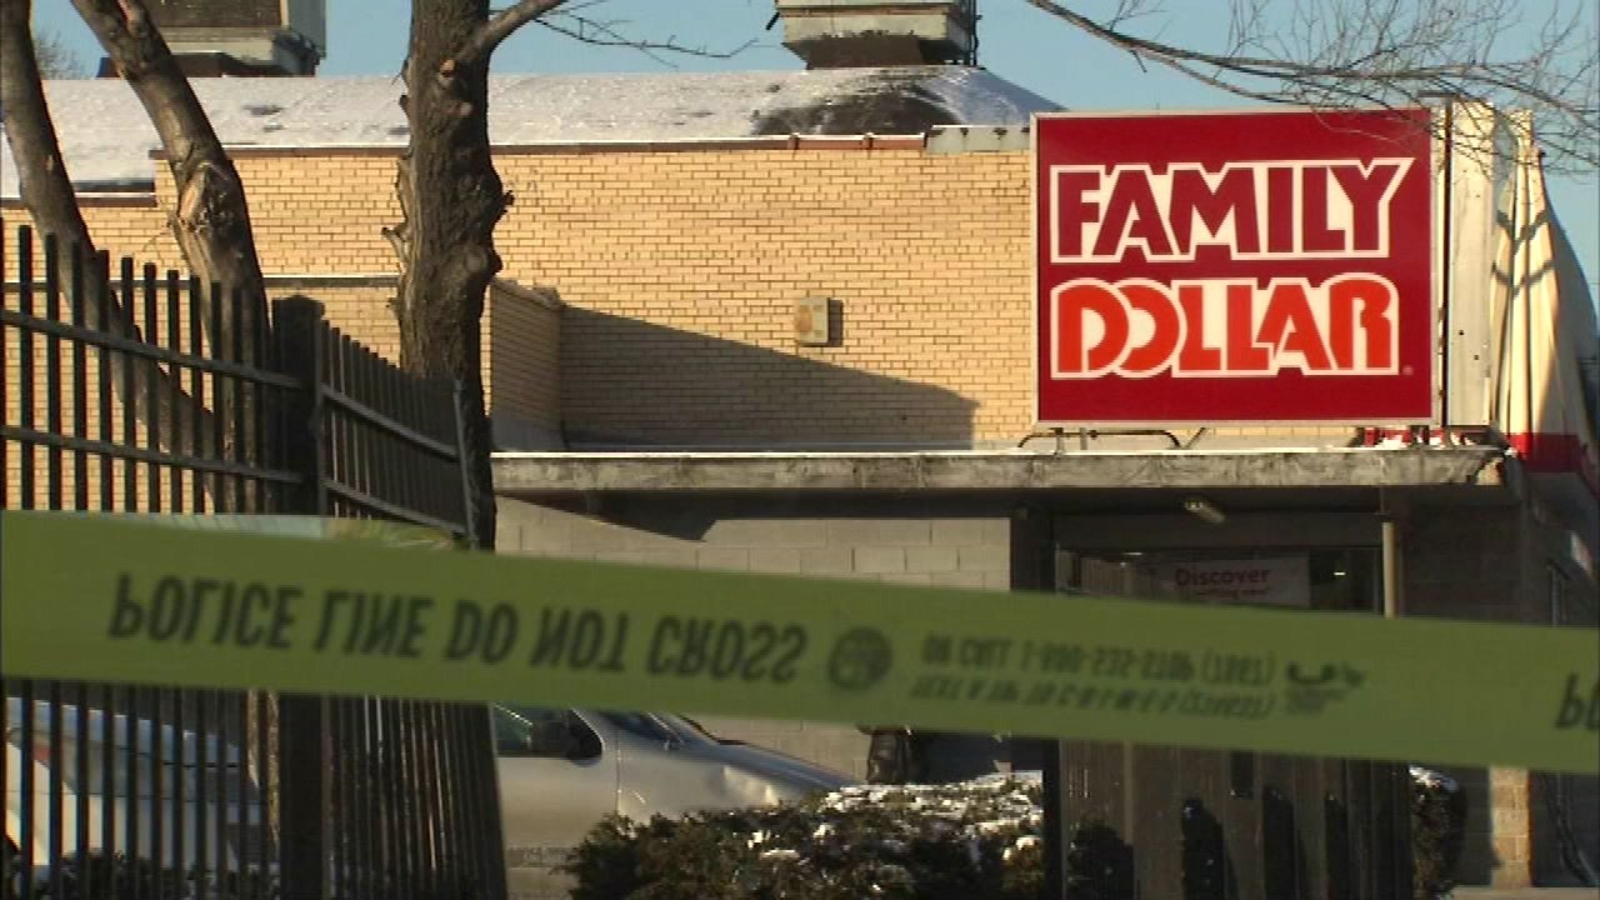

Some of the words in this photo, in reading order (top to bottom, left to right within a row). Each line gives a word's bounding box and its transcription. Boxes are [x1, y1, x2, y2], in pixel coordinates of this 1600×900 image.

[1050, 157, 1415, 263] FAMILY
[1050, 272, 1399, 380] DOLLAR
[1174, 568, 1271, 586] Discover
